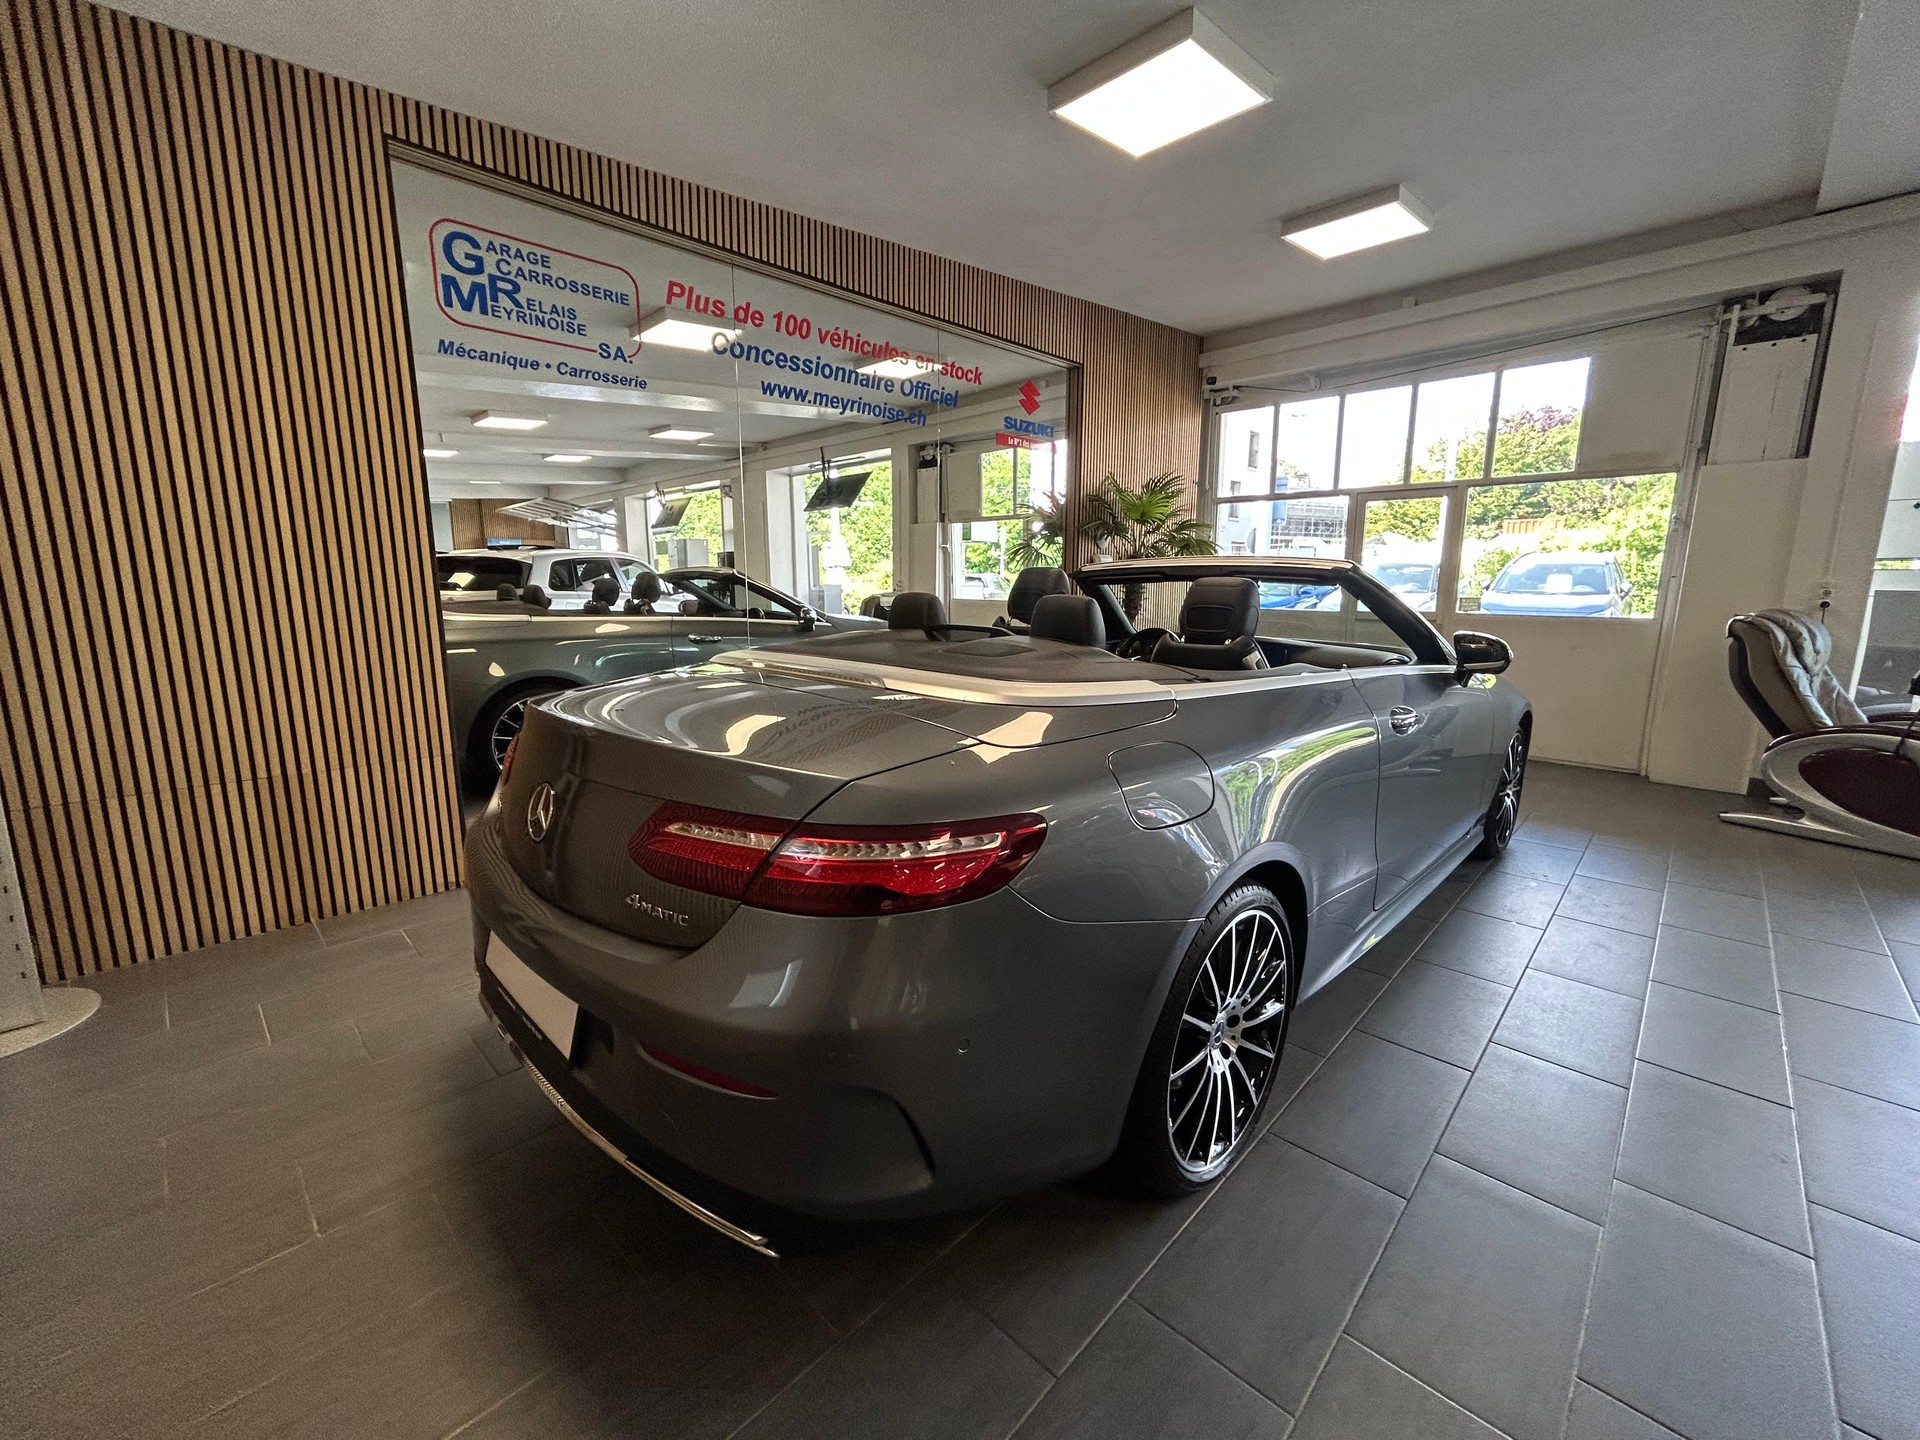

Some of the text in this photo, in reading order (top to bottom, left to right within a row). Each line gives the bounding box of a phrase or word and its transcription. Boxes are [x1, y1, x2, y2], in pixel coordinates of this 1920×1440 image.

[442, 230, 551, 275] GARAGE
[441, 273, 588, 337] MEYRINOISE
[487, 273, 577, 321] RELAIS
[495, 257, 630, 306] CARROSSERIE
[598, 342, 634, 364] SA.
[665, 280, 984, 385] Plus de 100 véhicules en stock
[437, 338, 648, 390] Mécanique Carrosserie
[711, 331, 960, 408] Concessionnaire Officiel
[760, 380, 927, 426] www.meyrinoise.ch
[1003, 415, 1055, 438] SUZUKI
[625, 893, 689, 926] 4MATIC
